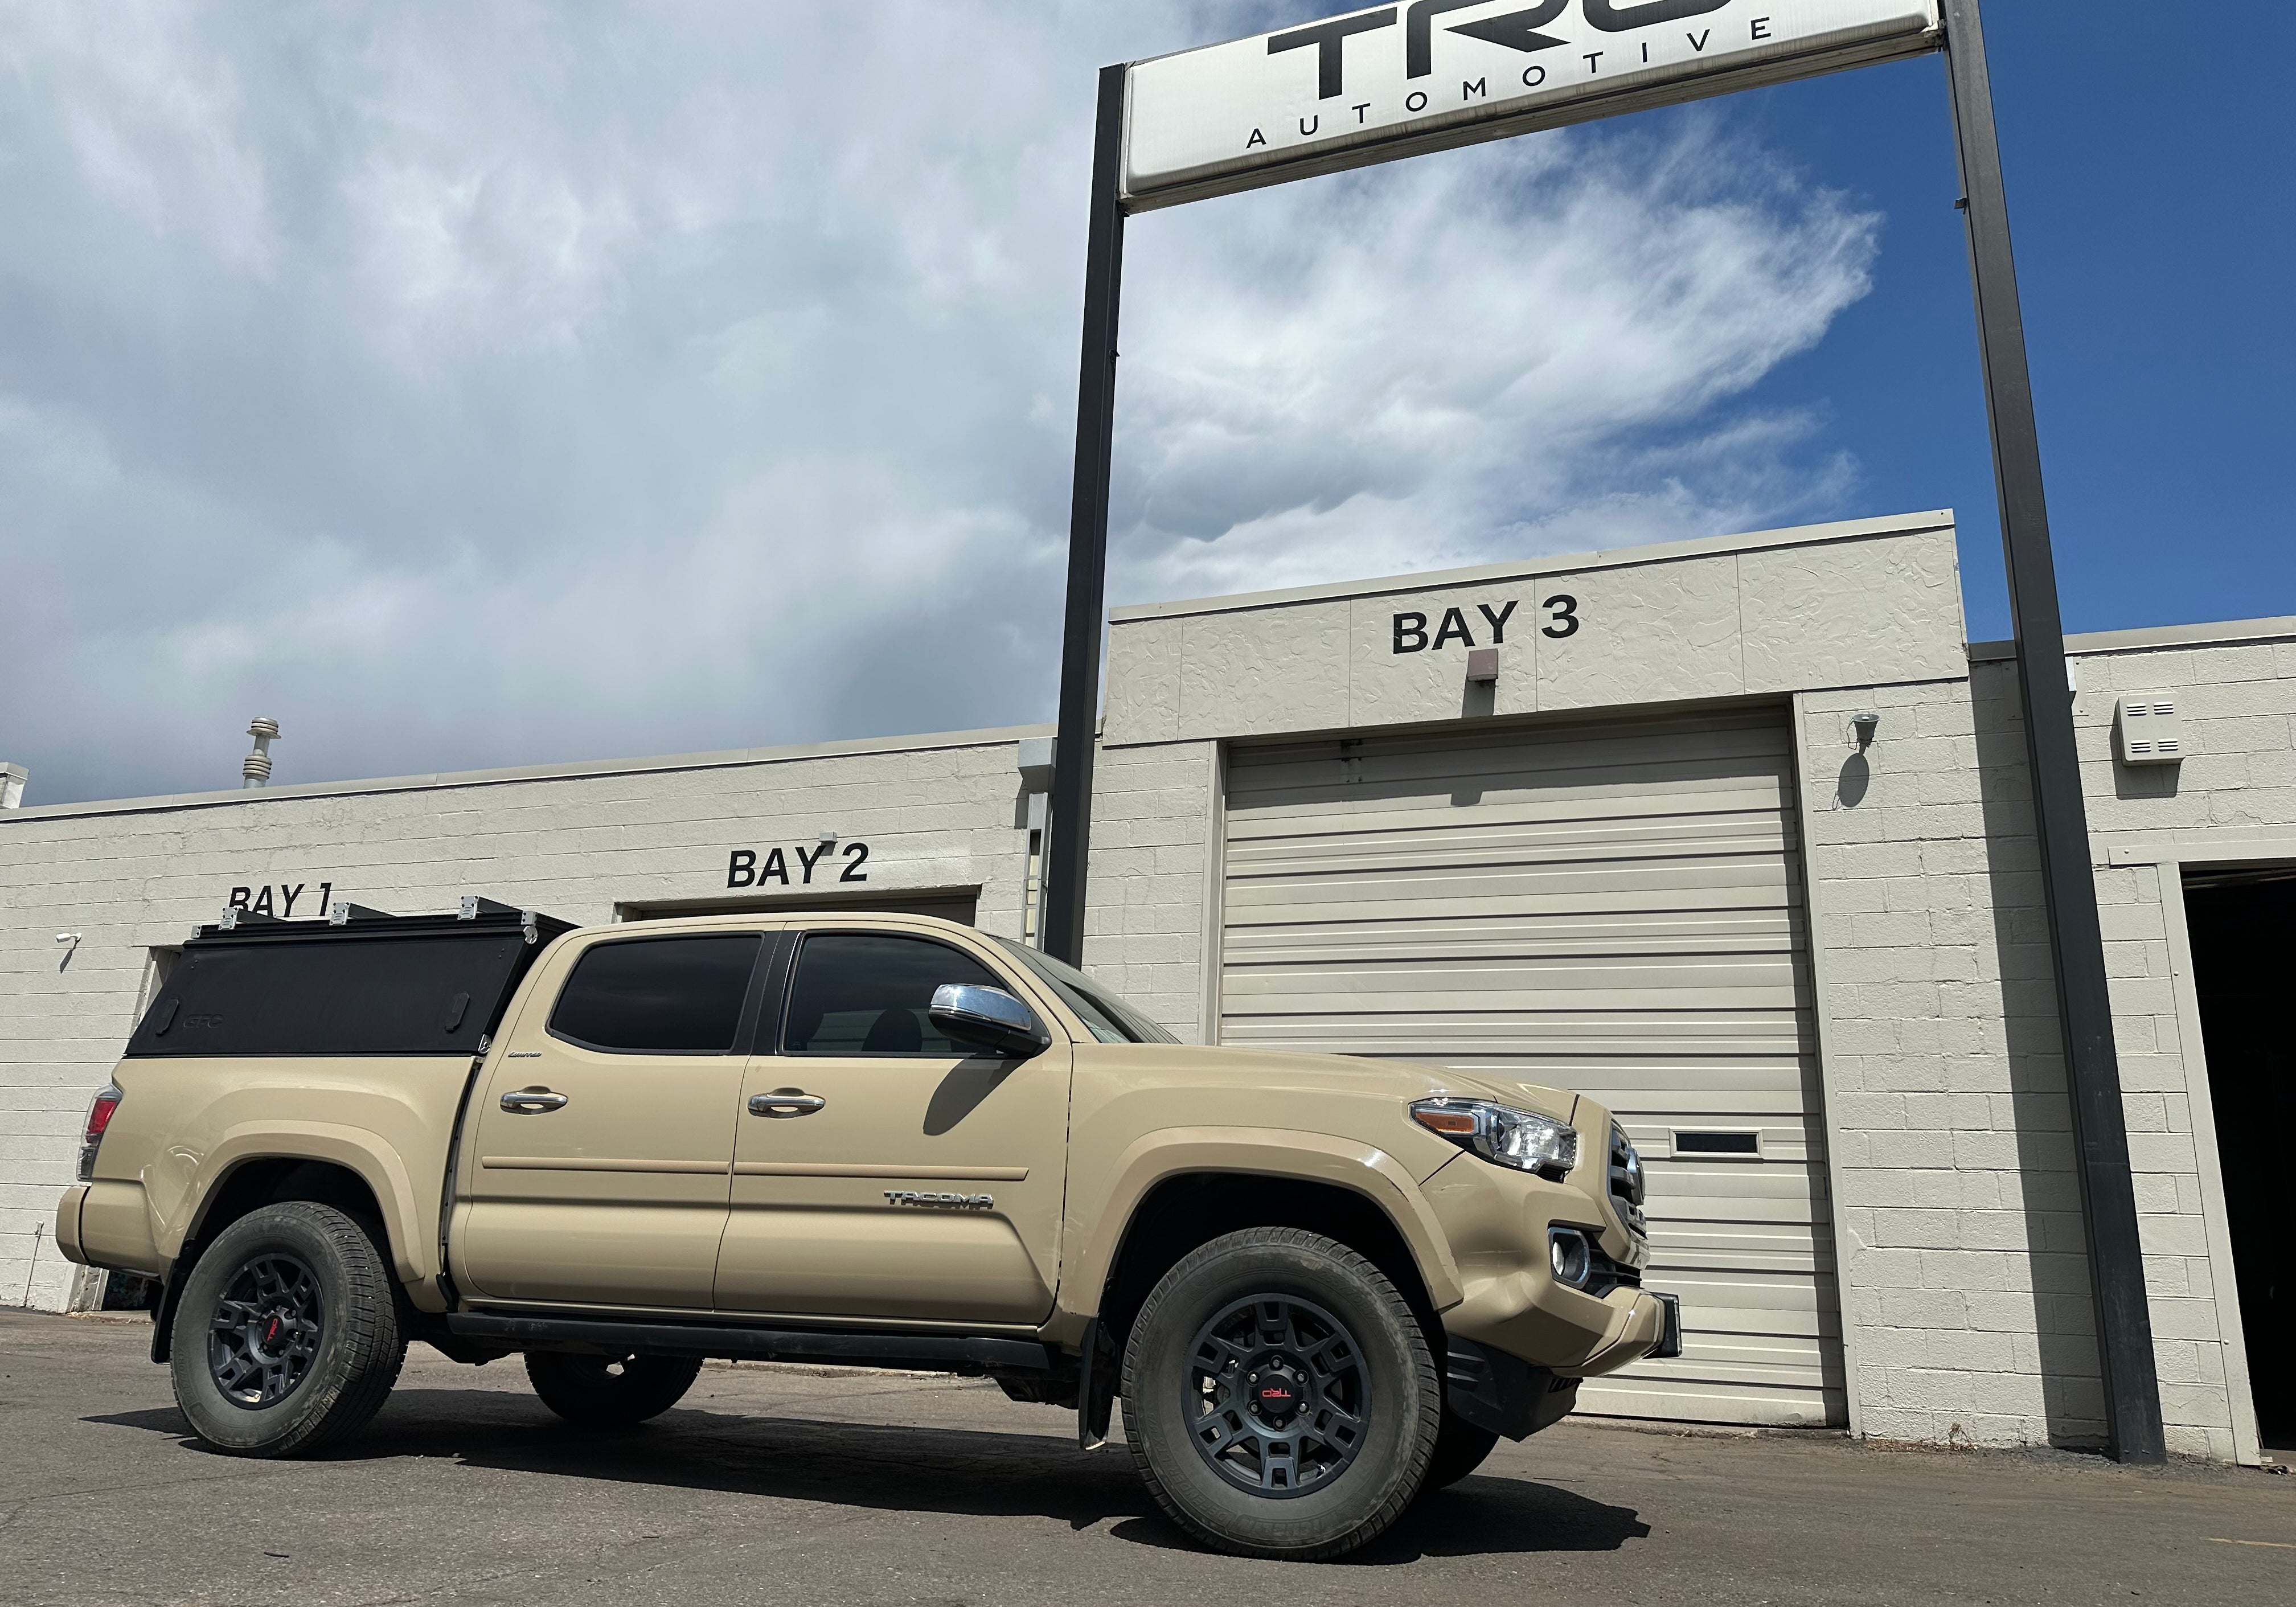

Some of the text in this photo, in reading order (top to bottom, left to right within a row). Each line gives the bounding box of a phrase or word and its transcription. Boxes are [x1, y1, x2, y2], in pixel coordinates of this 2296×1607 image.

[1267, 0, 1732, 100] TR
[1247, 17, 1772, 149] AUTOMOTIVE
[1393, 594, 1579, 654] BAY 3
[727, 842, 869, 888] BAY 2
[228, 882, 332, 917] BAY 1
[883, 1190, 994, 1210] TACOMA
[266, 1318, 278, 1341] TRD
[1262, 1388, 1292, 1397] TRD
[1169, 1467, 1228, 1522] DEFENDER
